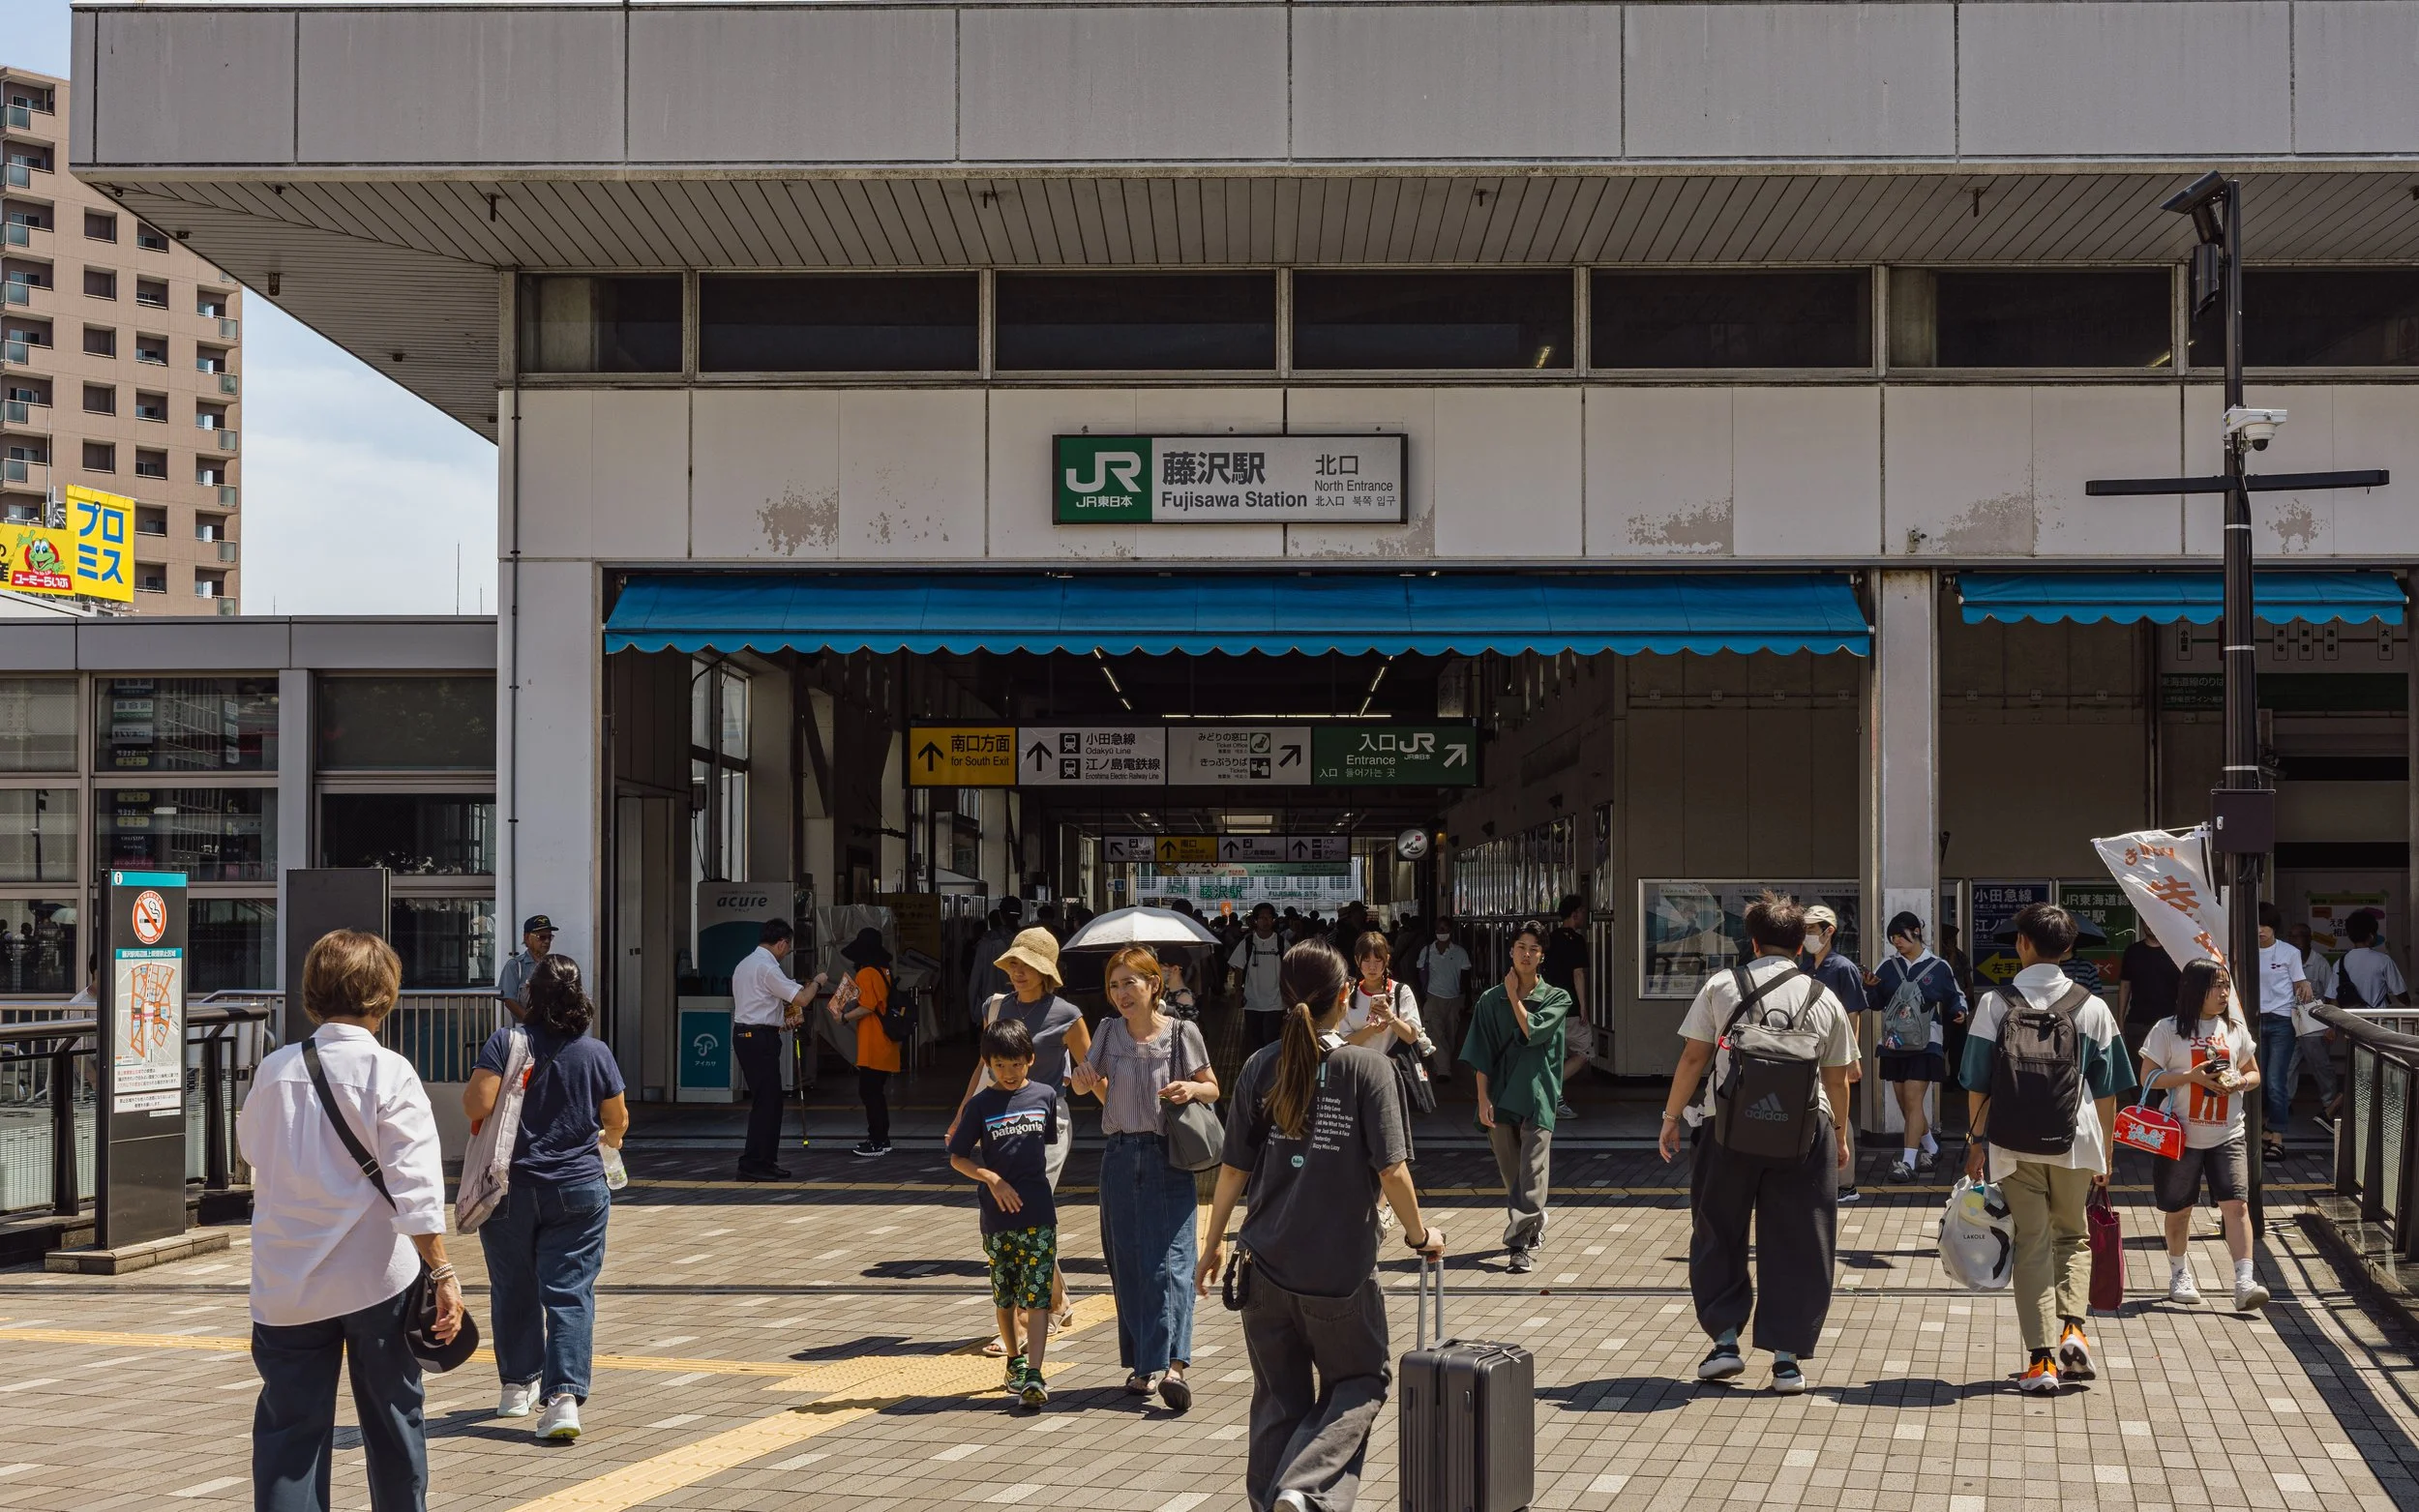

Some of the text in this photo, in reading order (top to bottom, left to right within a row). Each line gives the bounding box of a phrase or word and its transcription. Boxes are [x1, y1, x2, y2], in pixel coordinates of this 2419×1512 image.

[1066, 451, 1142, 493] JR
[1162, 452, 1266, 485] 藤沢駅
[1315, 454, 1359, 476] 北口
[1314, 480, 1393, 491] North Entrance
[1075, 494, 1133, 508] JR東日本
[1161, 490, 1307, 512] Fujisawa Station
[1315, 494, 1345, 508] 北入口
[1353, 494, 1396, 508] 북쪽 입구
[77, 501, 124, 544] プロ
[77, 544, 124, 584] ミス
[15, 574, 69, 588] ユーミーらいふ
[950, 734, 1010, 754] 南口方面
[1086, 732, 1136, 746] 小田急線
[1198, 732, 1248, 742] みどりの窓口
[1359, 733, 1396, 752] 入口
[1399, 732, 1436, 754] JR
[950, 756, 1010, 766] for South Exit
[1085, 757, 1160, 771] 江ノ島電鉄線
[1199, 757, 1248, 766] きっぷうりば
[1346, 755, 1396, 765] Entrance
[1319, 768, 1338, 778] 入口
[1345, 768, 1383, 778] 들어가는
[1199, 886, 1243, 899] 藤沢駅
[1974, 888, 2033, 903] 小田急線
[717, 897, 767, 907] acure
[2062, 894, 2130, 906] JR東海道線
[1975, 919, 2005, 933] 江ノ
[2330, 918, 2347, 928] えき
[1745, 1109, 1789, 1122] adidas
[991, 1121, 1044, 1141] patagonia
